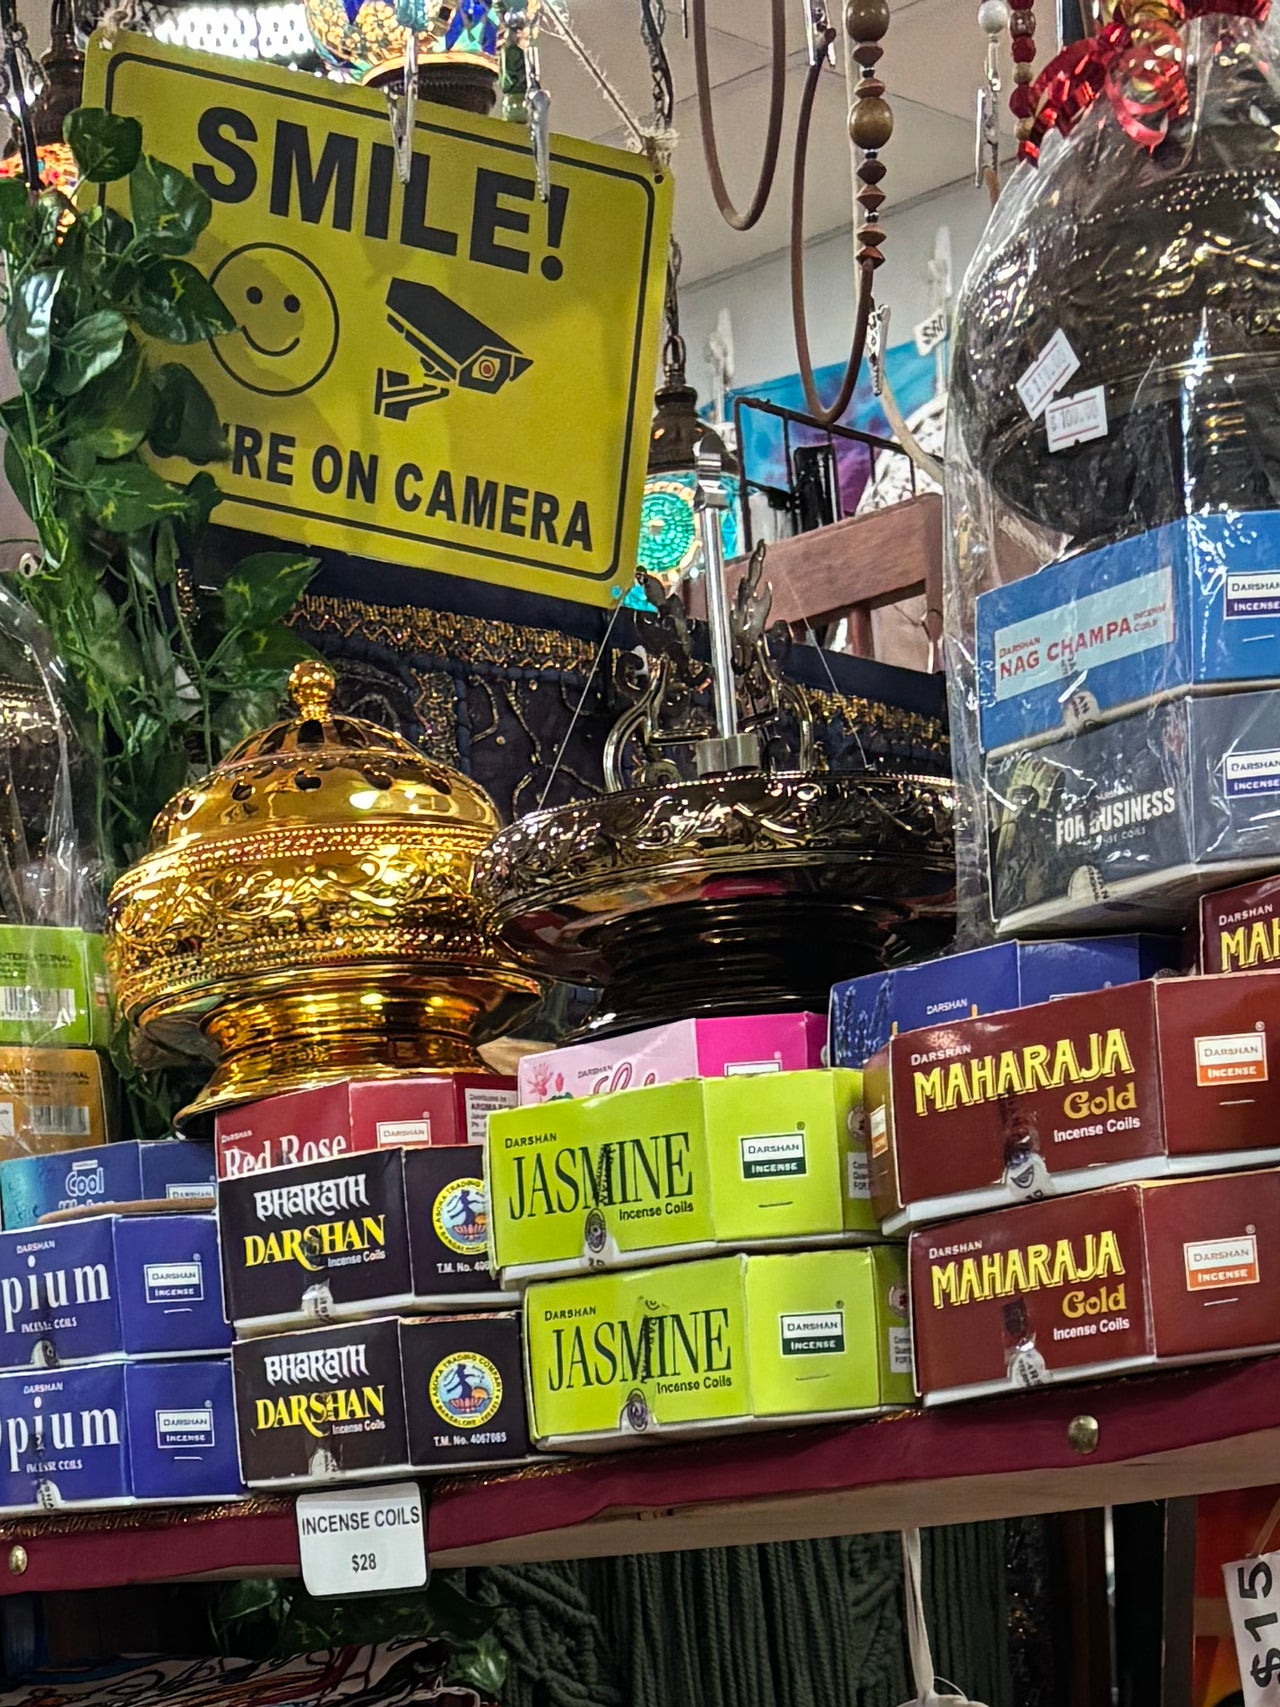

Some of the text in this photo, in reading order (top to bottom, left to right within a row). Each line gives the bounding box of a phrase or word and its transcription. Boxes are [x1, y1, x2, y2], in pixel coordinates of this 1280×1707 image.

[193, 106, 570, 282] SMILE!
[223, 424, 594, 552] 'RE ON CAMERA
[1233, 601, 1280, 612] INCENSE
[1000, 617, 1133, 680] NAG CHAMPA
[1233, 779, 1280, 791] INCENSE
[1219, 904, 1273, 926] DARSHAN
[926, 998, 969, 1016] DARSHAN
[910, 1043, 972, 1067] DARSHAN
[1204, 1044, 1259, 1058] DARSHAN
[912, 1028, 1137, 1118] MAHARAJA
[1207, 1065, 1257, 1080] INCENSE
[1063, 1082, 1138, 1121] Gold
[1053, 1115, 1141, 1144] Incense Coils
[505, 1132, 558, 1149] DARSHAN
[748, 1143, 799, 1155] DARSHAN
[223, 1134, 347, 1178] Red Rose
[509, 1131, 694, 1221] JASMINE
[751, 1162, 798, 1174] INCENSE
[65, 1167, 105, 1197] Cool
[619, 1201, 694, 1222] Incense Coils
[16, 1240, 56, 1254] DARSHAN
[244, 1214, 386, 1272] DARSHAN
[929, 1240, 983, 1259] DARSHAN
[327, 1251, 387, 1268] Incense Coils
[1193, 1247, 1250, 1263] DARSHAN
[152, 1271, 196, 1281] DARSHAN
[931, 1230, 1126, 1310] MAHARAJA
[1197, 1268, 1249, 1283] INCENSE
[155, 1288, 195, 1297] INCENSE
[1062, 1283, 1127, 1319] Gold
[545, 1306, 596, 1322] DARSHAN
[53, 1317, 78, 1330] COILS
[787, 1320, 839, 1333] DARSHAN
[1053, 1317, 1130, 1341] Incense Coils
[548, 1308, 731, 1392] JASMINE
[790, 1339, 836, 1351] INCENSE
[23, 1381, 63, 1394] DARSHAN
[657, 1376, 732, 1395] Incense Coils
[255, 1385, 386, 1438] DARSHAN
[163, 1418, 207, 1427] DARSHAN
[332, 1419, 386, 1435] Incense Coils
[166, 1434, 205, 1443] INCENSE
[453, 1435, 469, 1446] No.
[58, 1459, 82, 1471] COILS
[301, 1504, 420, 1535] INCENSE COILS
[351, 1551, 377, 1573] $28
